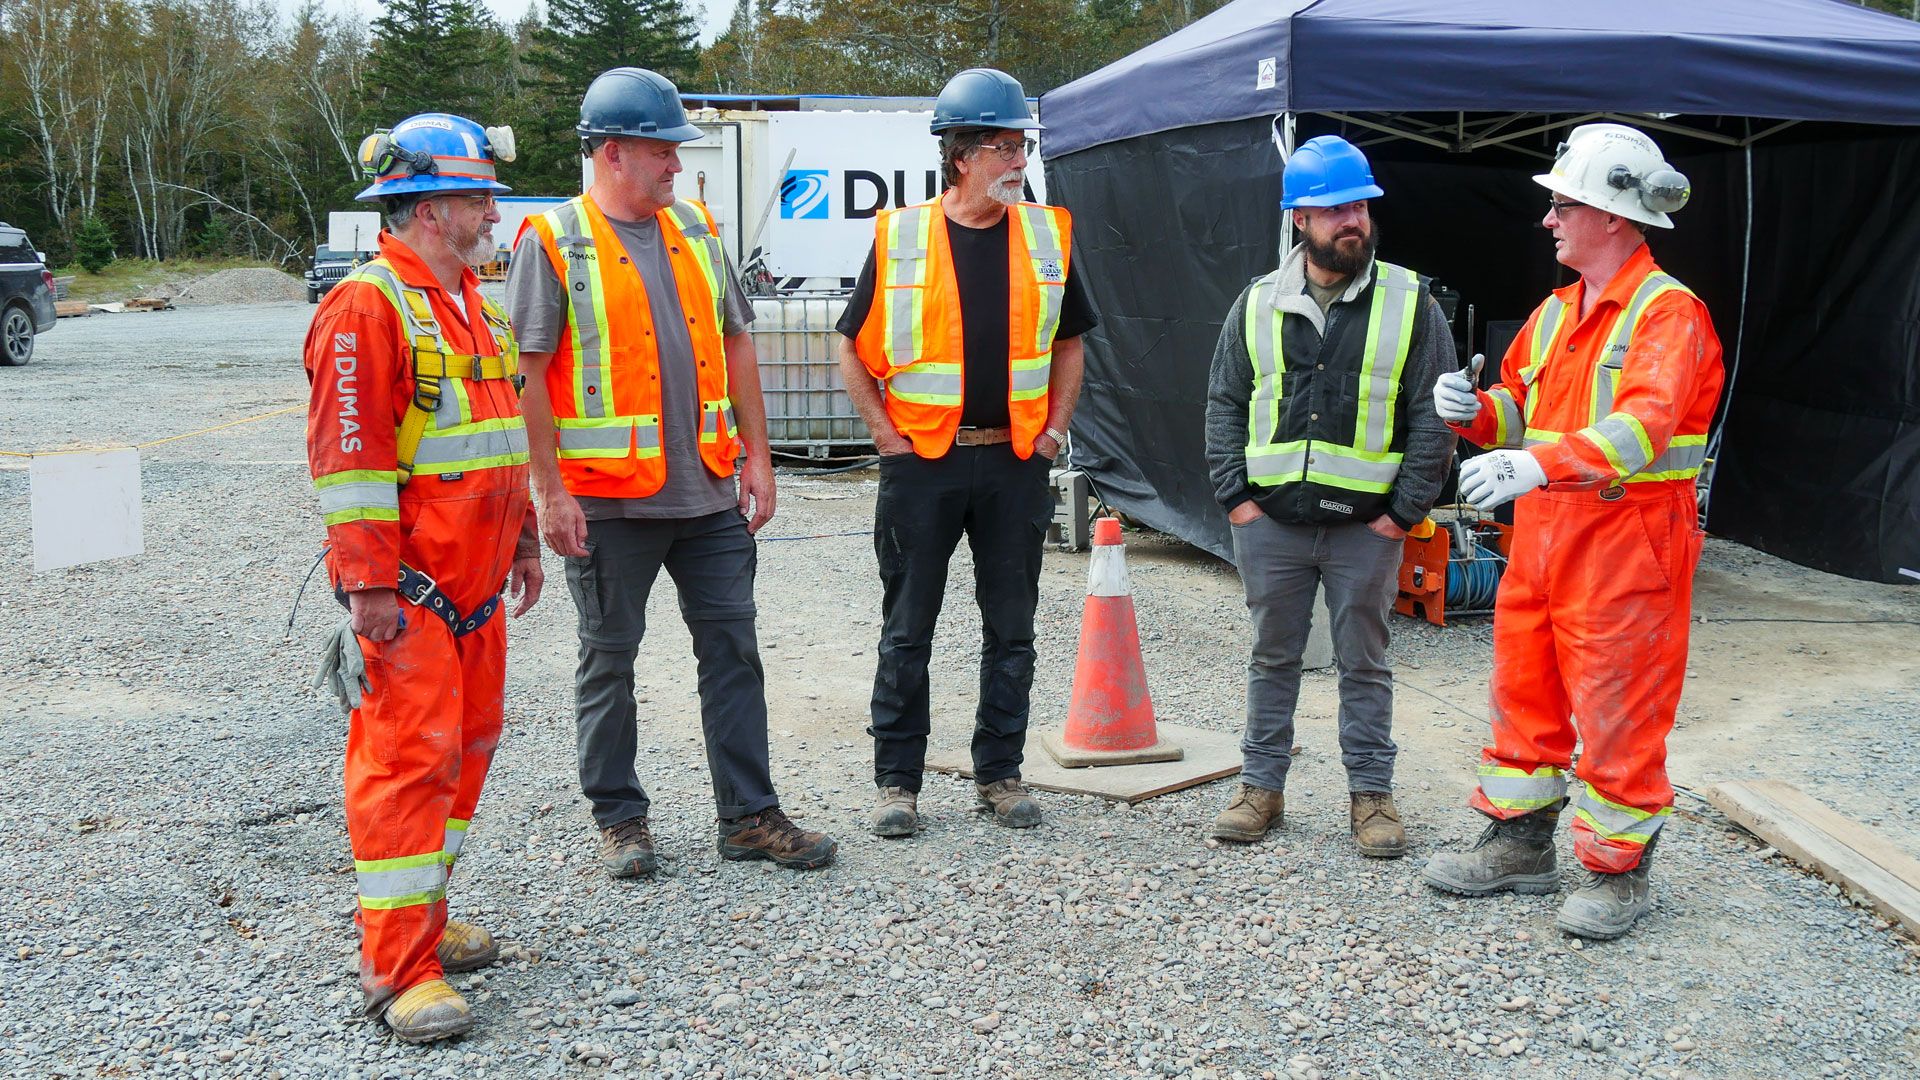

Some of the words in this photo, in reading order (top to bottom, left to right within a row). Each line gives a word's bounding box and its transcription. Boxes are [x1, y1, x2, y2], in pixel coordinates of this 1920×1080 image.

[844, 170, 1037, 219] DU
[336, 357, 362, 453] DUMAS
[1322, 501, 1351, 513] DAKOTA
